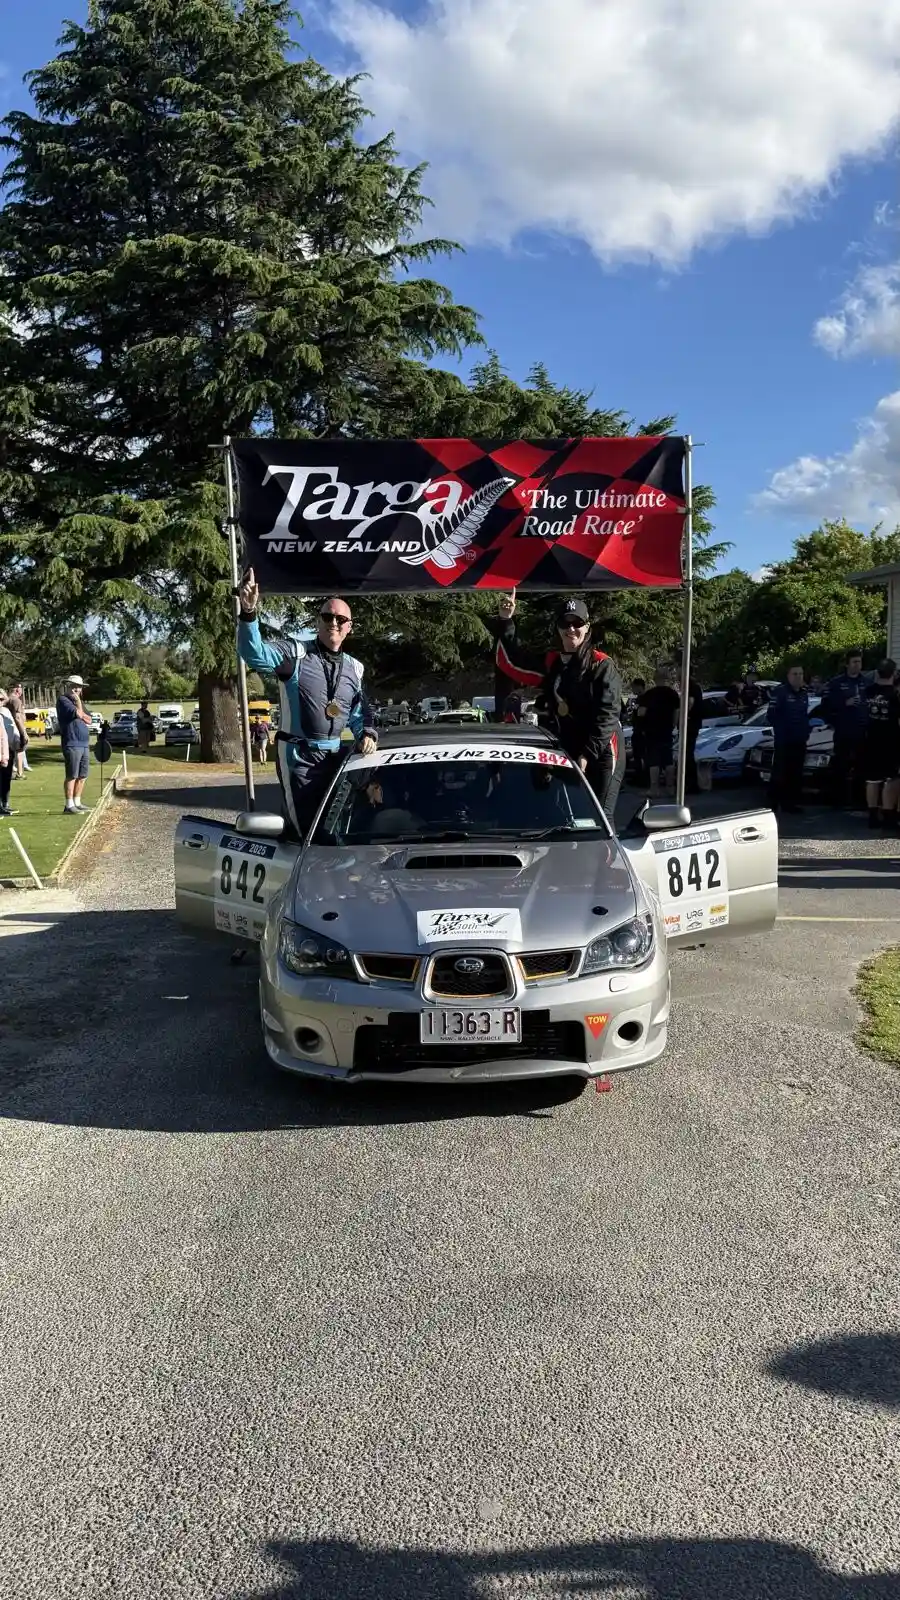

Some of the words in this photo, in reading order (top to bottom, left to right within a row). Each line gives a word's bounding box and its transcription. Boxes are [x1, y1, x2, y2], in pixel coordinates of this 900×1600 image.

[258, 464, 463, 540] Targa
[574, 489, 667, 510] Ultimate
[520, 514, 578, 537] Road
[267, 540, 317, 553] NEW
[322, 540, 421, 553] ZEALAND
[381, 750, 449, 764] Targa
[465, 750, 485, 758] NZ
[489, 750, 537, 761] 2025
[689, 832, 711, 845] 2025
[248, 843, 267, 855] 2025
[220, 854, 266, 904] 842
[667, 848, 721, 898] 842
[430, 912, 490, 927] Targa
[664, 914, 681, 925] Vital
[587, 1015, 607, 1024] TOW
